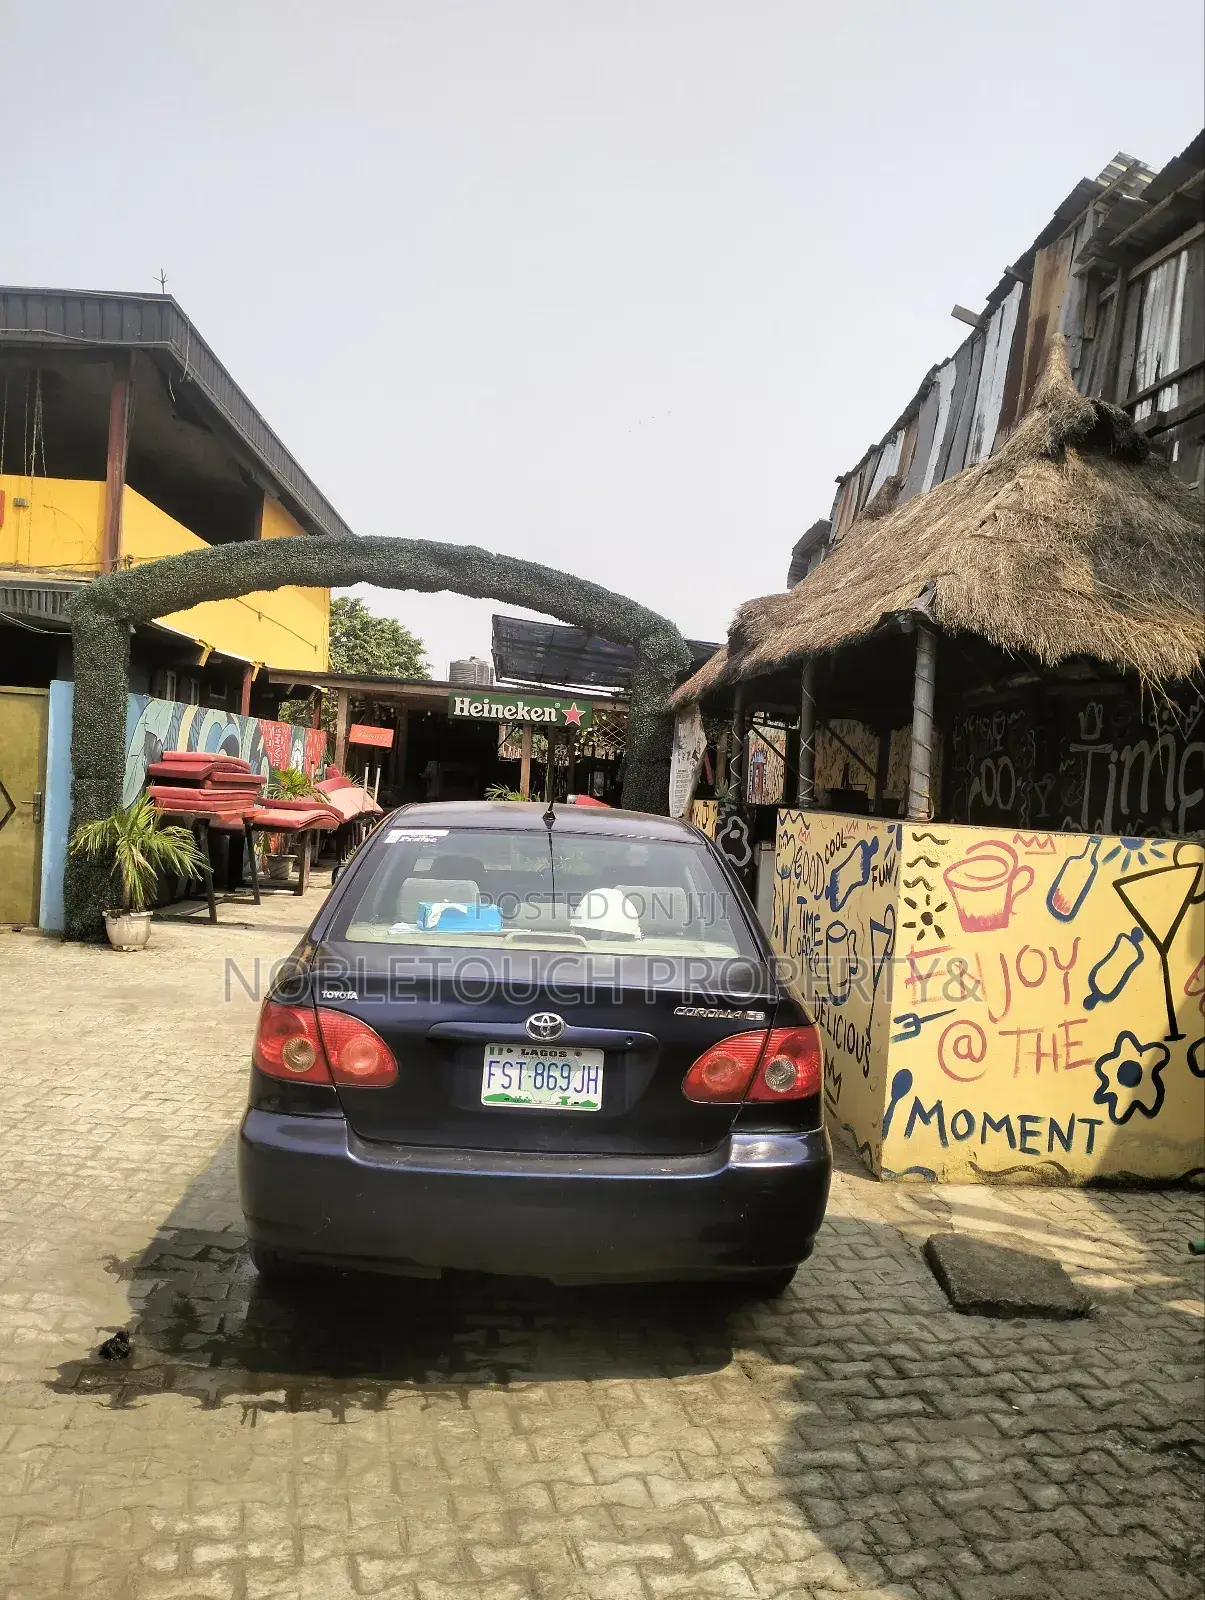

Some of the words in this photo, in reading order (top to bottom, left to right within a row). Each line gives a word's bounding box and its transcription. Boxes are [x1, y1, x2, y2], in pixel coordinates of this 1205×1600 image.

[454, 697, 557, 722] Heineken
[825, 828, 848, 864] COOL
[794, 846, 825, 900] GOOD
[796, 896, 823, 946] TIME
[321, 990, 359, 1000] TOYOTA
[904, 937, 1081, 1024] ENJOY
[674, 1007, 742, 1019] COROLLA
[813, 989, 872, 1079] DELICIOUS
[520, 1048, 568, 1058] LAGOS
[938, 1019, 988, 1083] @
[998, 1018, 1097, 1079] THE
[904, 1096, 1104, 1157] MOMENT
